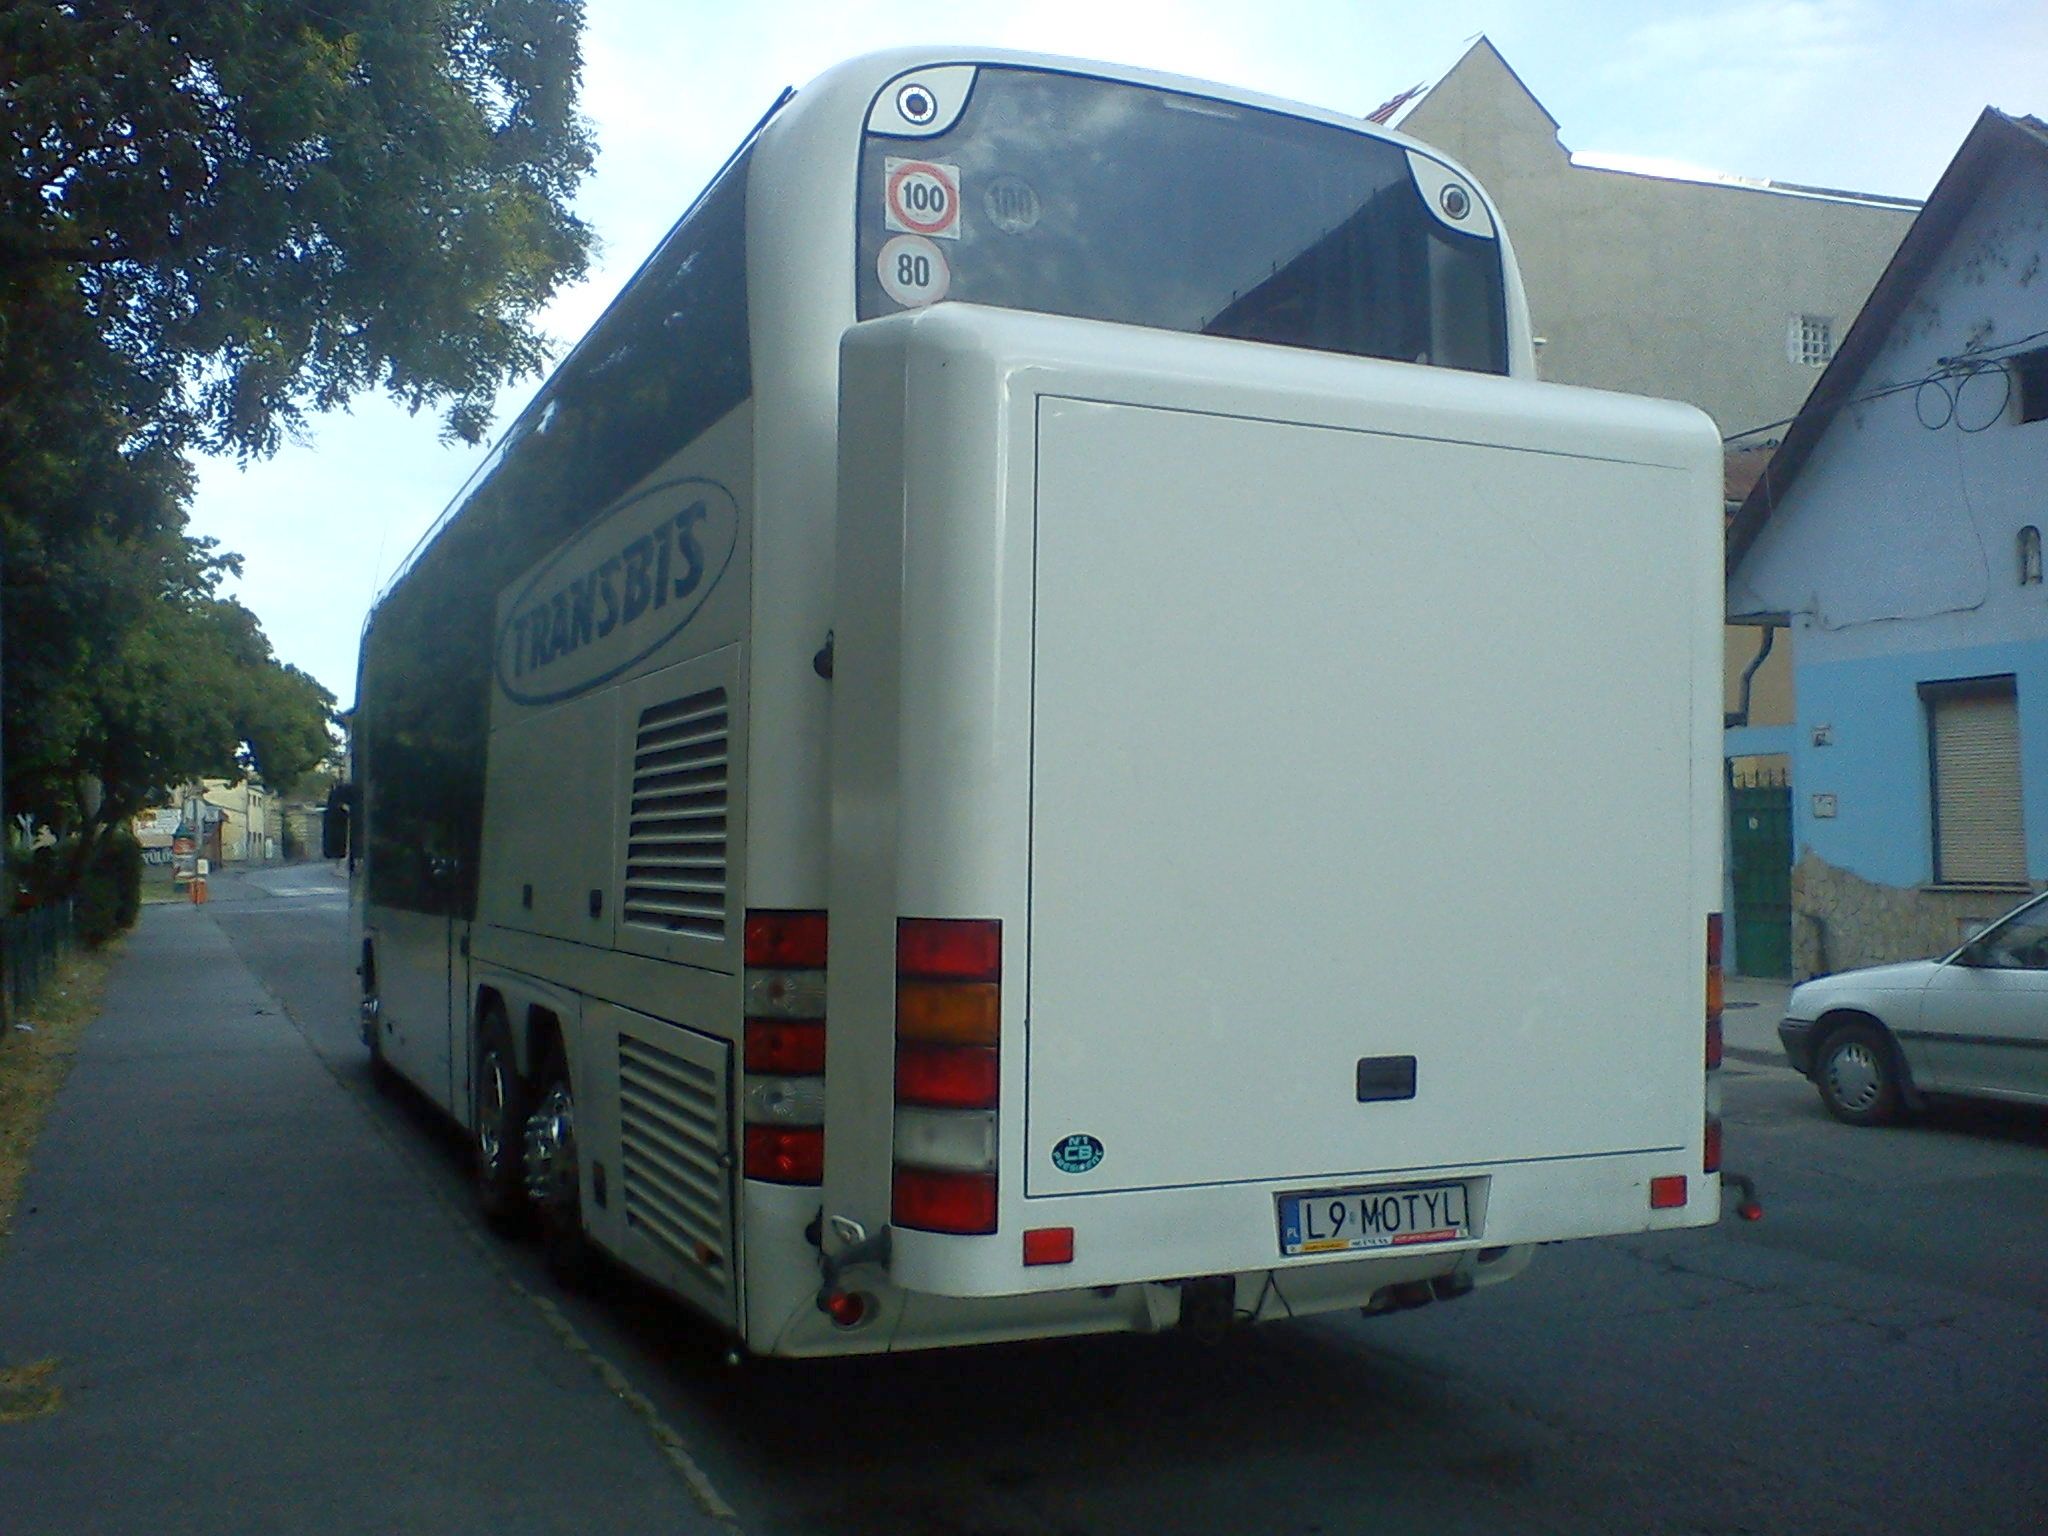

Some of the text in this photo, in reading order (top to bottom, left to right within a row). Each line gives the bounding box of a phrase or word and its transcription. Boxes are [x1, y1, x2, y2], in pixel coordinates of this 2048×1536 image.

[903, 181, 945, 213] 100
[897, 253, 930, 287] 80
[1306, 1191, 1460, 1240] L9 MOTYL
[1286, 1228, 1299, 1238] PL
